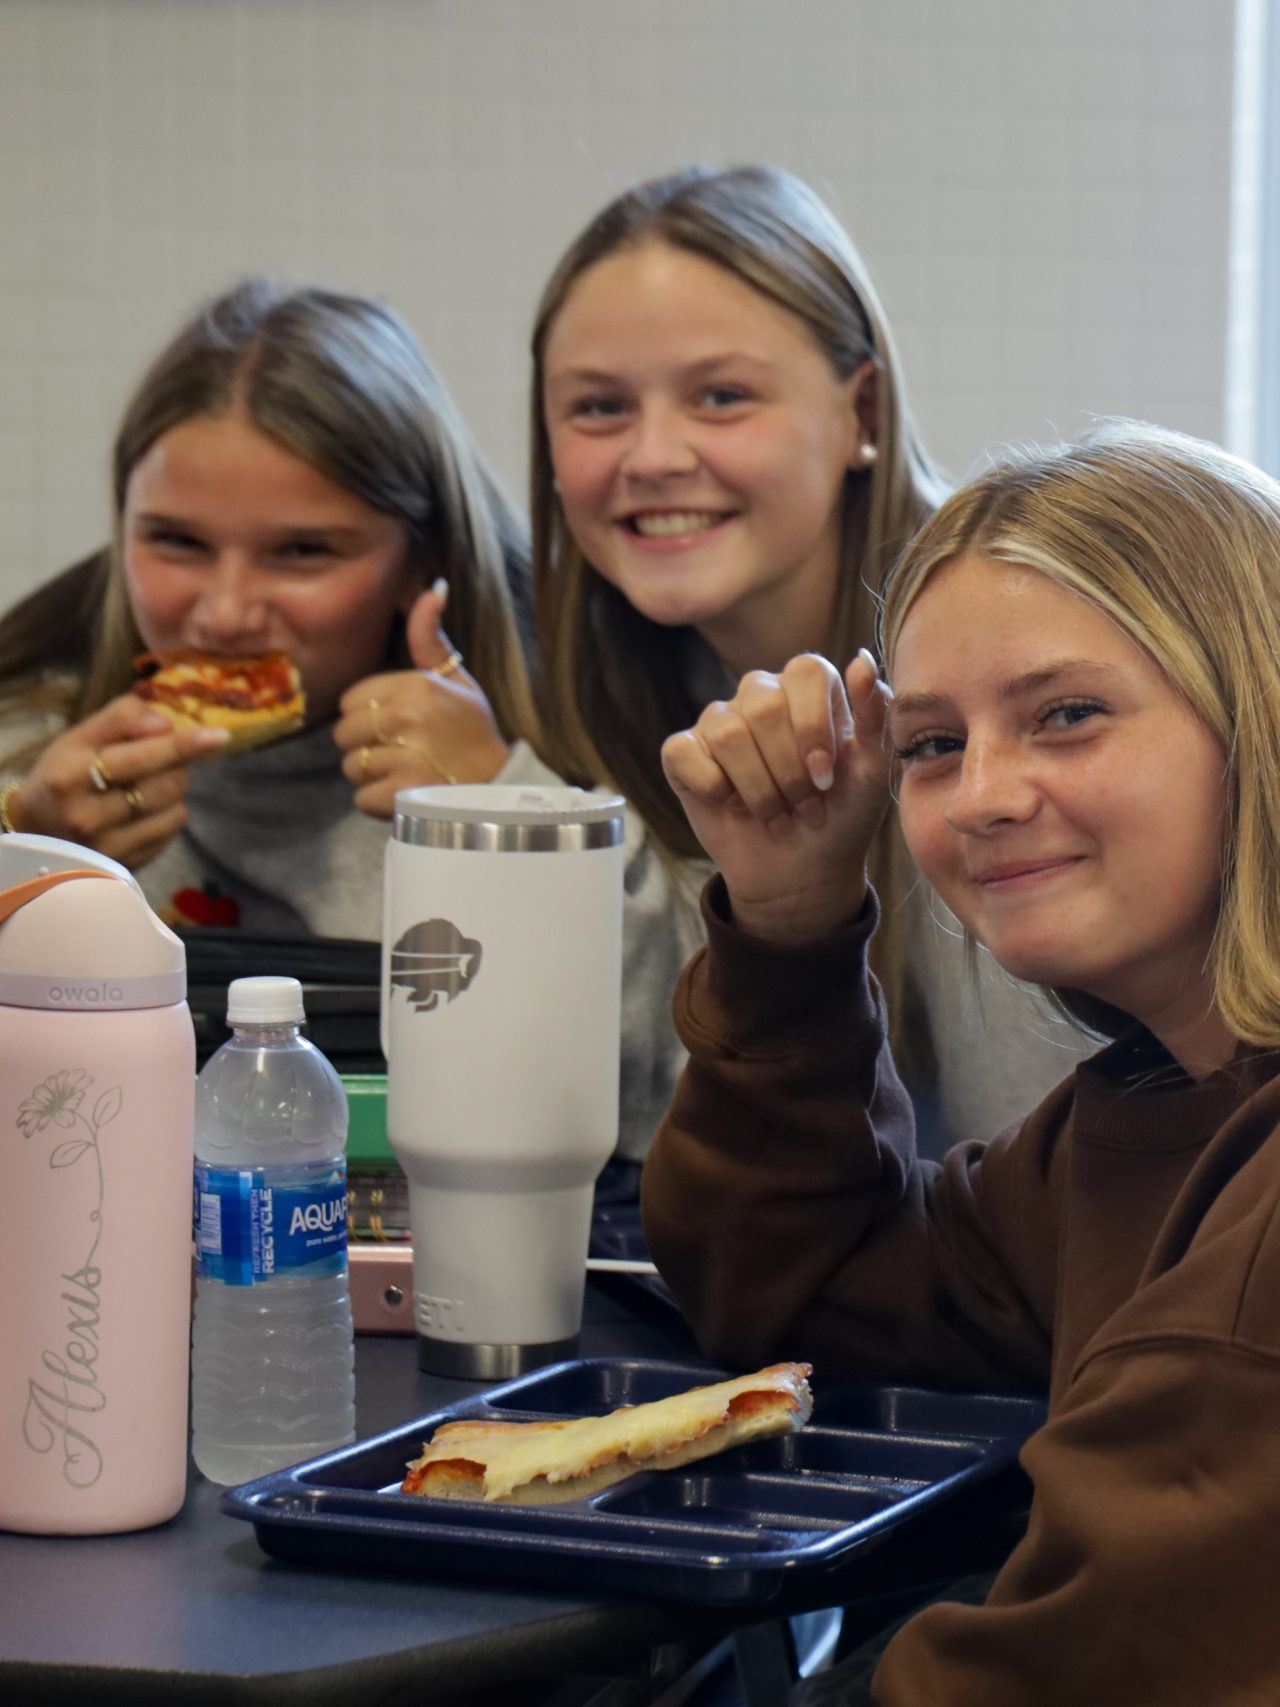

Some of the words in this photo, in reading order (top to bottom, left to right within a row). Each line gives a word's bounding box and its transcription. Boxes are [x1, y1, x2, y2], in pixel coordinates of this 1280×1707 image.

[48, 983, 124, 1002] owala
[250, 1189, 259, 1220] THEN
[260, 1188, 275, 1274] RECYCLE
[22, 1264, 107, 1490] Alexis
